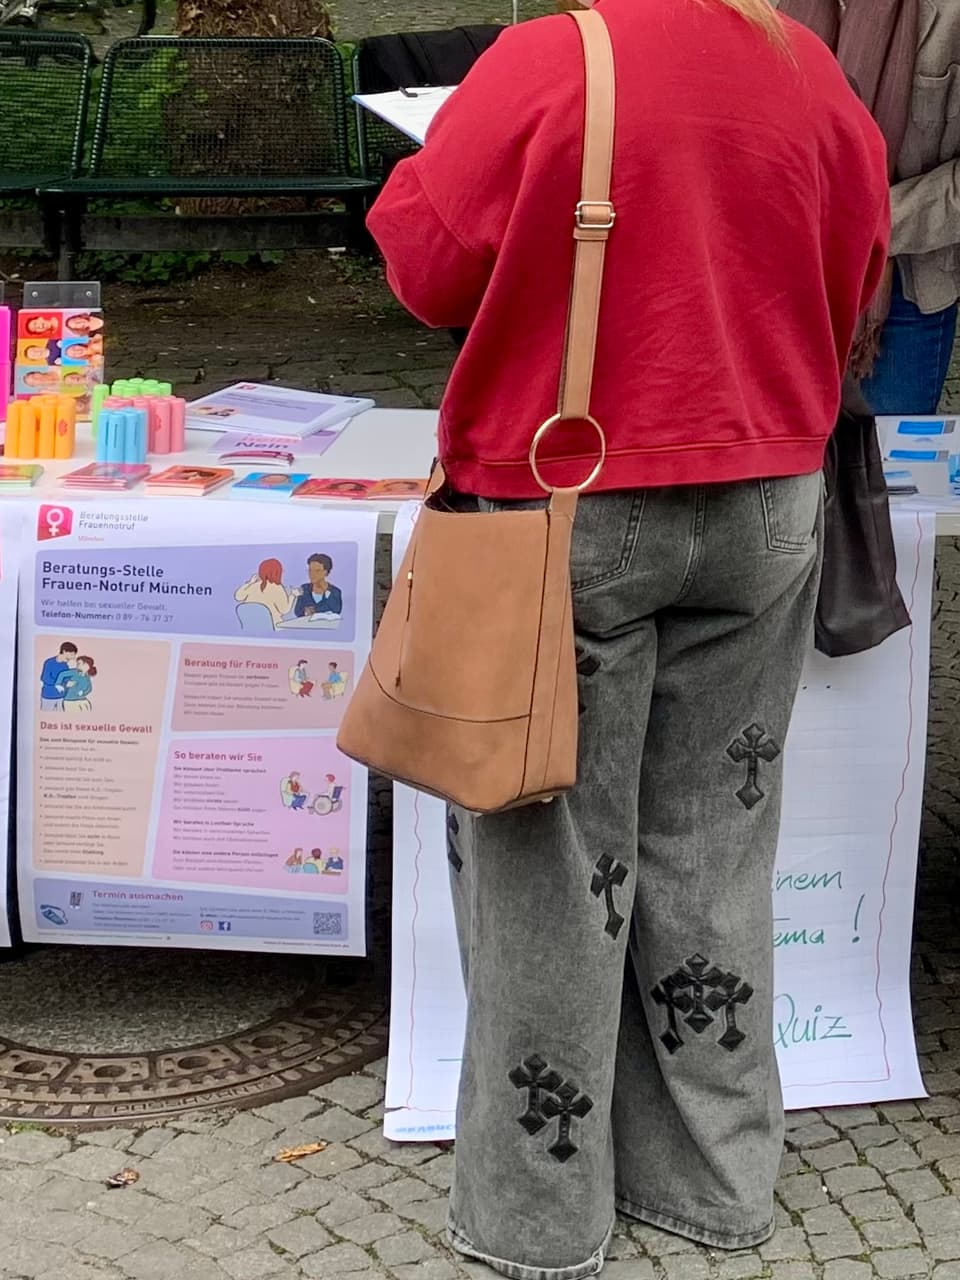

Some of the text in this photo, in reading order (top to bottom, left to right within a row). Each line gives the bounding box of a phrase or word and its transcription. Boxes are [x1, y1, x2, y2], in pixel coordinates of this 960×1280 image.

[80, 511, 149, 522] Beratungsstelle
[78, 520, 136, 531] Frauennotruf
[42, 561, 165, 579] Beratungs-Stelle
[41, 578, 213, 596] Frauen-Notruf München
[184, 658, 279, 670] Beratung für Frauen
[40, 721, 152, 733] Das ist sexuelle Gewalt
[174, 750, 263, 762] So beraten wir Sie
[775, 870, 842, 891] inem
[92, 890, 184, 902] Termin ausmachen
[773, 920, 825, 948] ema
[774, 993, 852, 1049] Quiz
